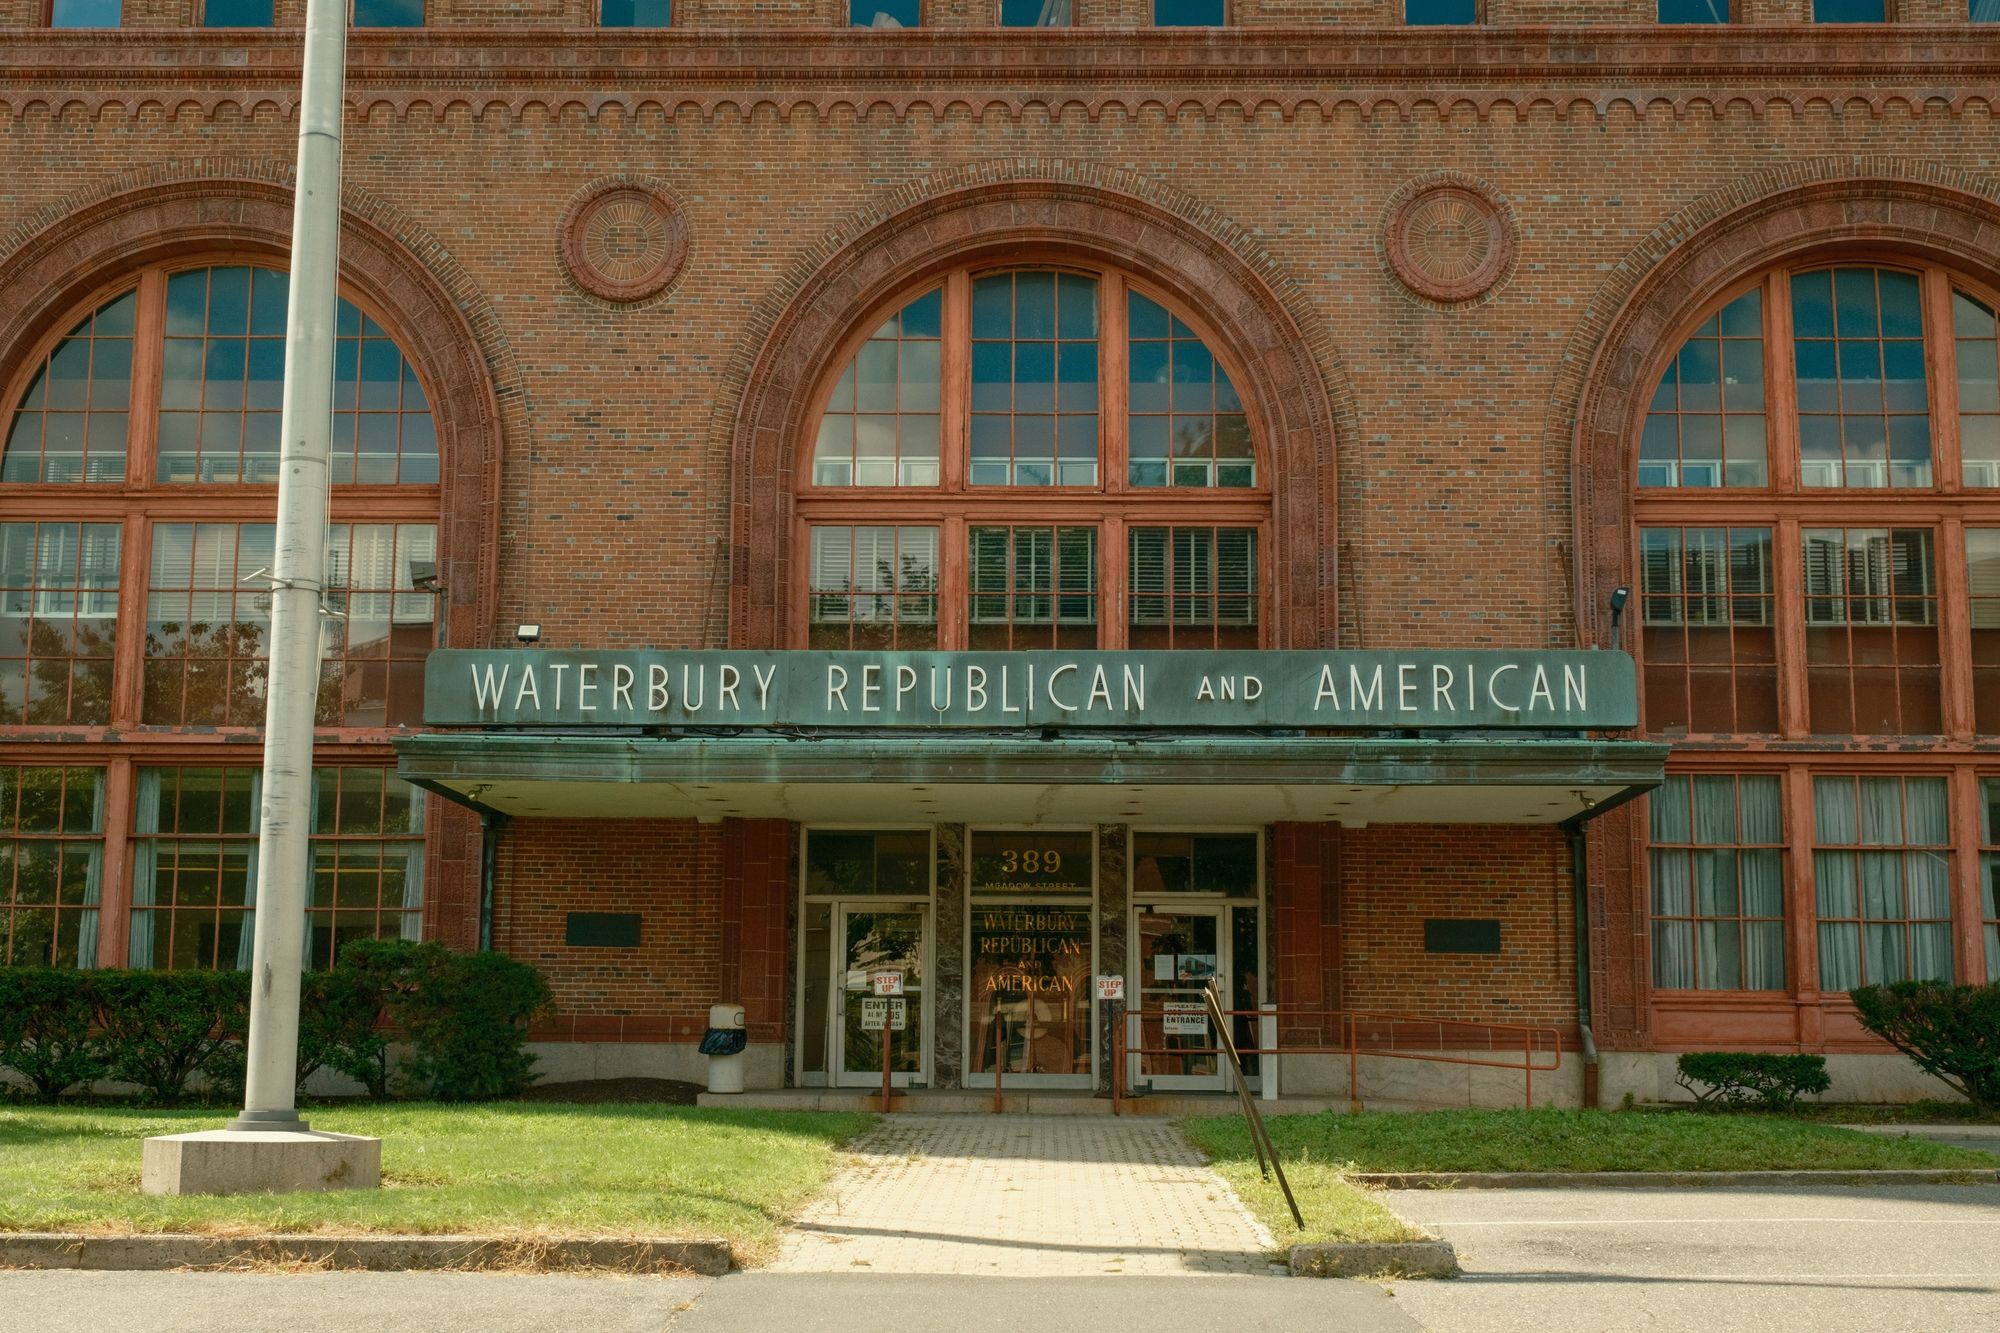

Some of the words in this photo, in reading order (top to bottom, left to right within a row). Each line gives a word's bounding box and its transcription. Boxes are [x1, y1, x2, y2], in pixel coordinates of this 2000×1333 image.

[471, 663, 777, 711] WATERBURY
[827, 664, 1146, 712] REPUBLICAN
[1197, 675, 1263, 701] AND
[1314, 664, 1588, 712] AMERICAN
[1002, 850, 1061, 873] 389
[985, 882, 1031, 890] MEADOW
[1036, 882, 1077, 890] STREET
[984, 914, 1077, 931] WATERBURY
[981, 937, 1080, 954] REPUBLICAN
[1018, 961, 1042, 969] AND
[876, 976, 898, 984] STEP
[985, 975, 1073, 992] AMERICAN
[1098, 980, 1121, 988] STEP
[882, 985, 894, 993] UP
[1104, 989, 1117, 997] UP
[865, 1001, 903, 1009] ENTER
[1167, 1016, 1205, 1024] ENTRANCE
